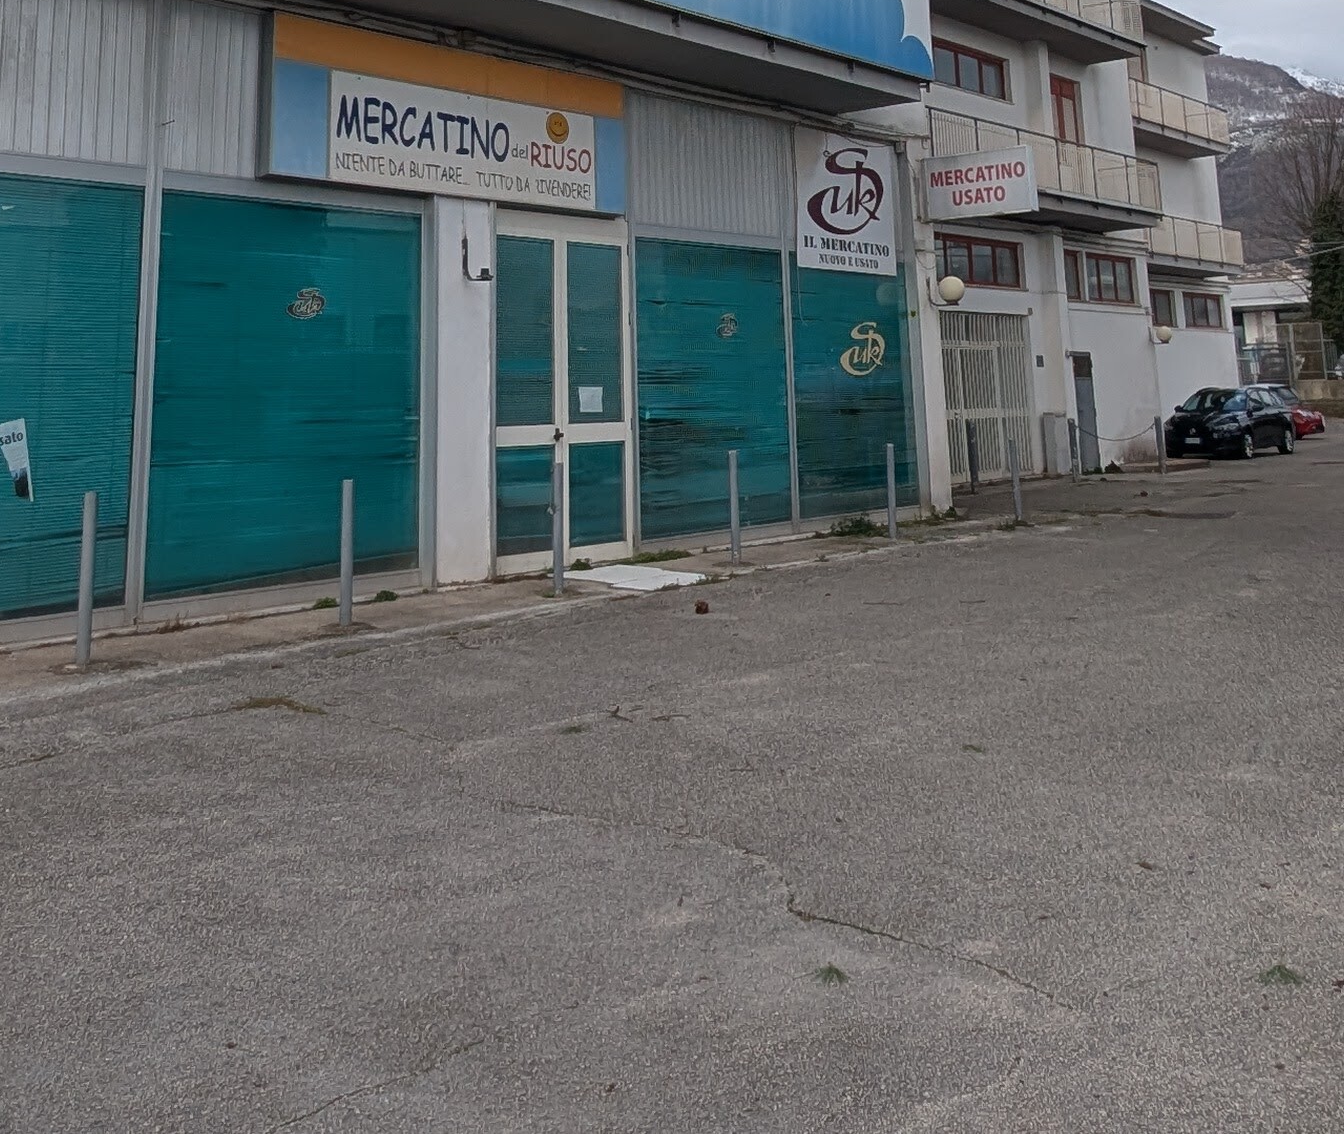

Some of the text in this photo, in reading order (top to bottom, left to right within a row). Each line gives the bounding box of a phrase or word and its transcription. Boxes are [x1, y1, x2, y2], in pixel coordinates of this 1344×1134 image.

[336, 94, 592, 174] MERCATINO del RIUSO
[335, 152, 385, 176] NIENTE
[388, 158, 406, 177] DA
[476, 170, 514, 191] TUTTO
[516, 175, 531, 194] DA
[930, 161, 1026, 188] MERCATINO
[952, 185, 1006, 207] USATO
[803, 234, 890, 258] IL MERCATINO
[818, 253, 879, 269] NUOVO E USATO
